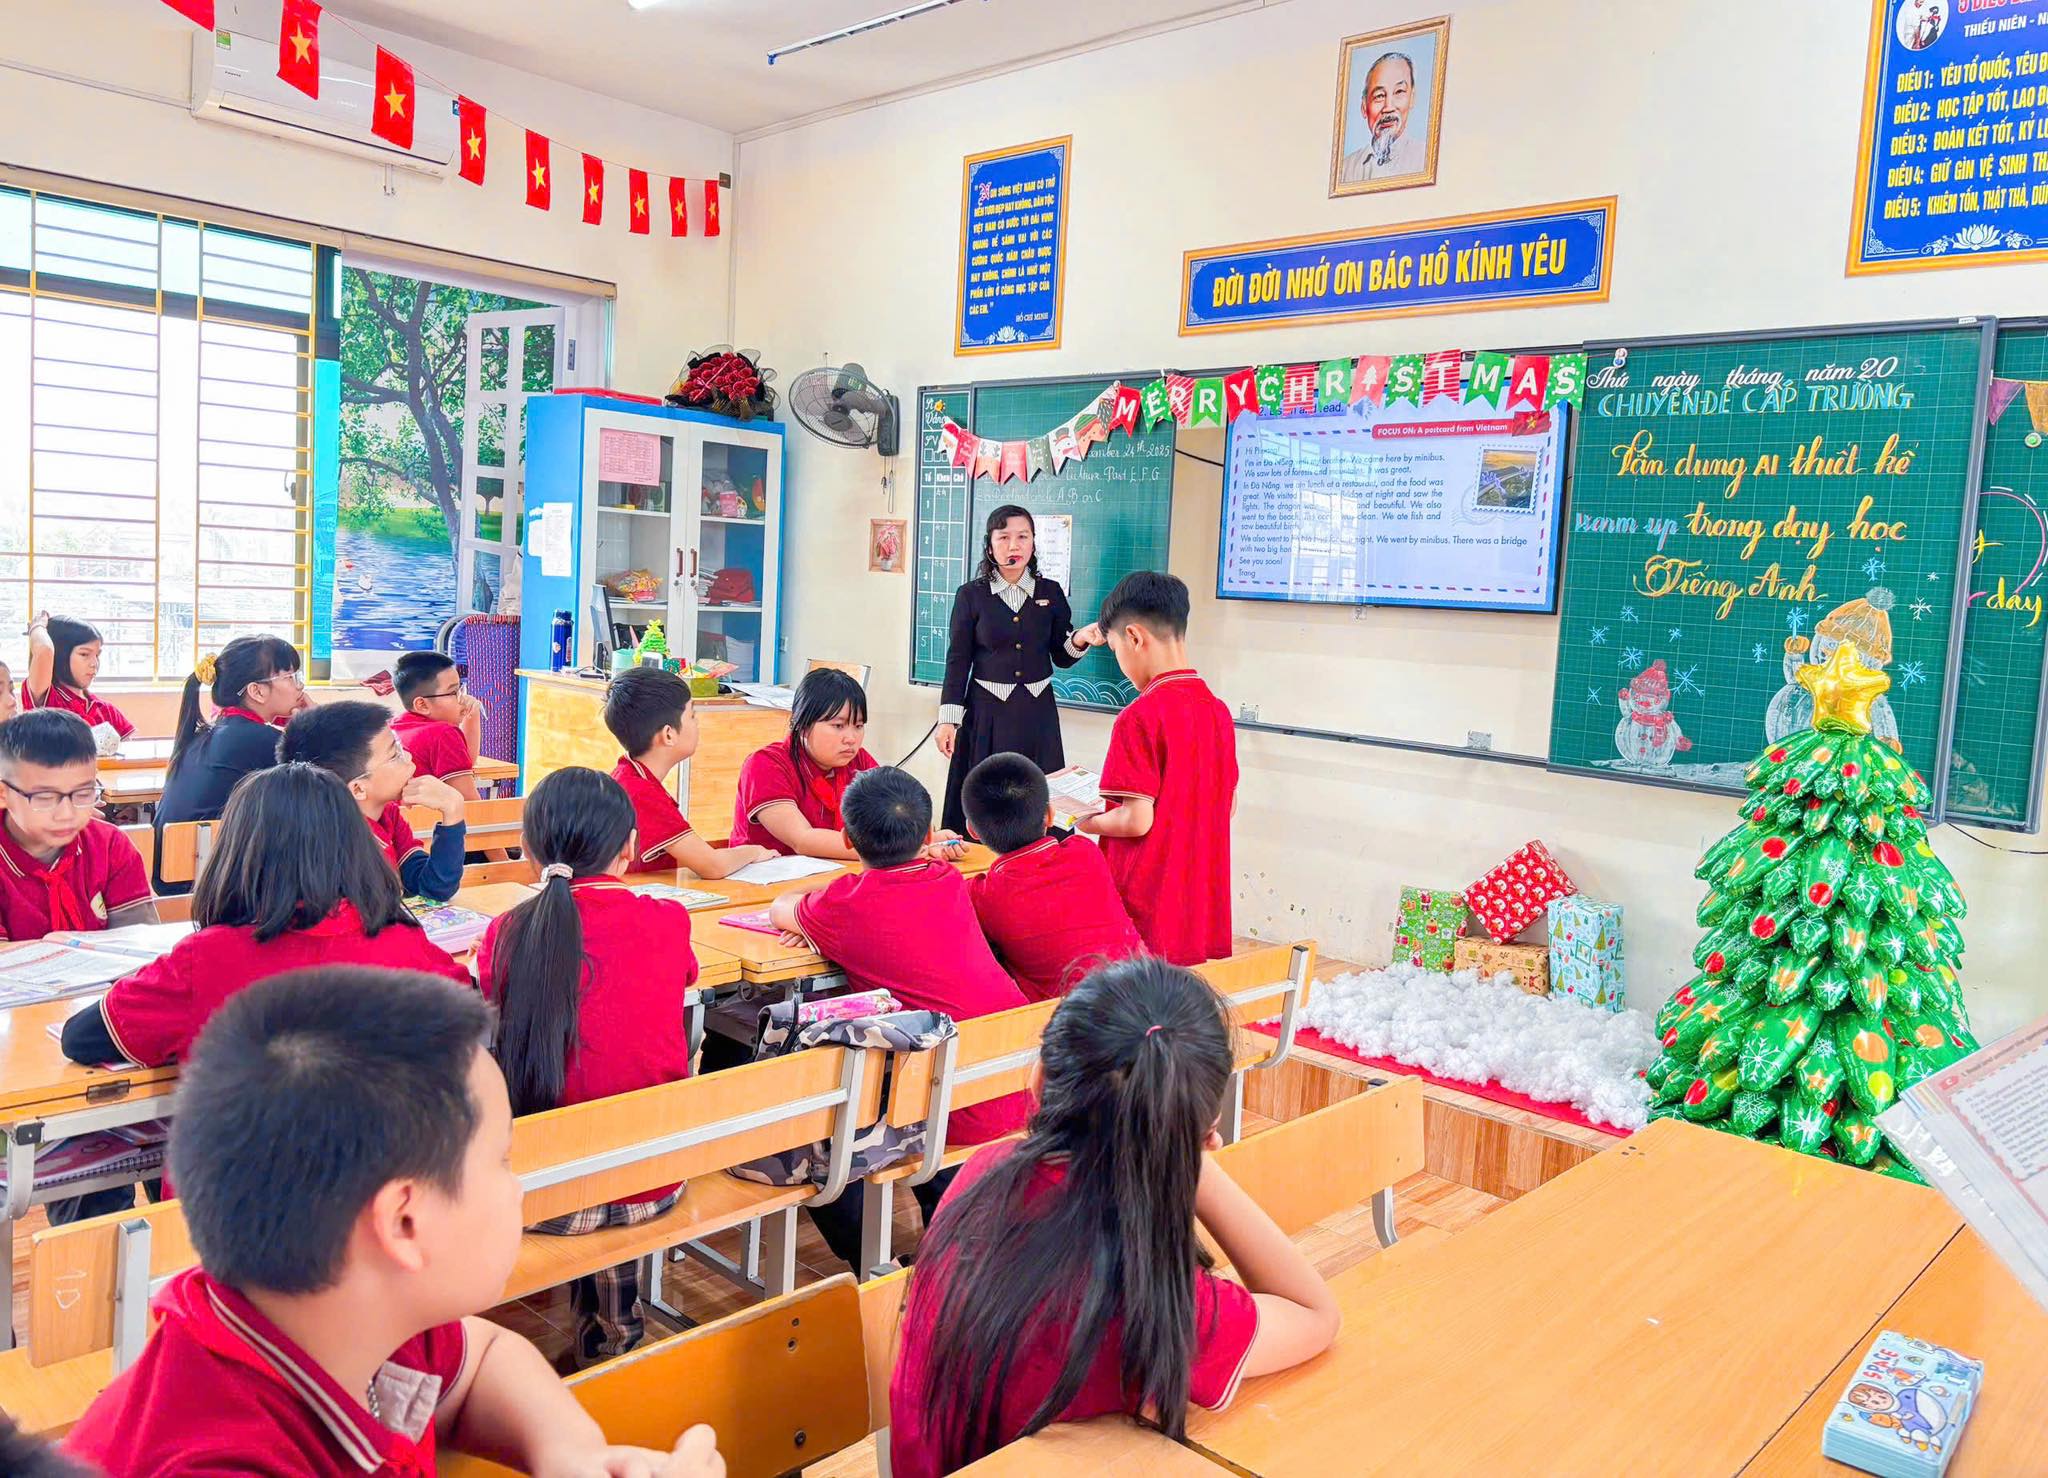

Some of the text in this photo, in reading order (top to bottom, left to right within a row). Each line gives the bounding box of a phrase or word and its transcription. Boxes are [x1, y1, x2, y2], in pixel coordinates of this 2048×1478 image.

[1964, 14, 2027, 37] THIẾU NIÊN
[1897, 51, 2037, 93] ĐIỀU 1: YÊU TỔ QUỐC, YÊU
[1894, 84, 2035, 124] ĐIỀU 2: HỌC TẬP TỐT, LAO
[1891, 111, 2035, 156] ĐIỀU 3: ĐOÀN KẾT TỐT, KỶ
[1888, 153, 2028, 188] ĐIỀU 4: GIỮ GÌN VỆ SINH
[1884, 183, 2028, 219] ĐIỀU 5: KHIÊM TỐN, THẬT THÀ,
[1212, 232, 1568, 308] ĐỜI ĐỜI NHỚ ƠN BÁC HỒ KÍNH YÊU
[1586, 356, 1898, 396] Thứ ngày tháng năm 20
[1115, 378, 1250, 423] MERRY
[1742, 379, 1798, 413] CẤP
[1377, 427, 1401, 436] FOCUS
[1416, 426, 1423, 434] A
[1424, 425, 1455, 436] postcard
[1456, 425, 1474, 434] from
[1476, 423, 1508, 432] Vietnam
[1385, 452, 1445, 464] here by minibus.
[1753, 454, 1780, 475] AI
[1284, 468, 1291, 476] of
[1390, 466, 1412, 476] great.
[1380, 478, 1394, 487] and
[1396, 478, 1408, 486] the
[1410, 477, 1426, 486] food
[1264, 492, 1275, 500] We
[1375, 489, 1394, 500] night
[1396, 489, 1411, 497] and
[1431, 489, 1443, 497] the
[1263, 502, 1275, 510] The
[1277, 502, 1301, 512] dragon
[1357, 500, 1371, 509] and
[1373, 500, 1406, 509] beautiful.
[1410, 500, 1423, 508] We
[1426, 500, 1442, 508] also
[1266, 512, 1277, 520] the
[1357, 512, 1378, 520] clean.
[1382, 511, 1394, 520] We
[1397, 512, 1408, 520] ate
[1411, 511, 1423, 520] fish
[1426, 511, 1441, 520] and
[1255, 522, 1282, 530] beautiful
[1643, 517, 1679, 551] up
[1684, 502, 1766, 560] trong
[1772, 505, 1835, 559] dạy
[1847, 495, 1907, 552] học
[1267, 544, 1278, 554] big
[1409, 535, 1418, 545] by
[1420, 536, 1450, 544] minibus.
[1453, 536, 1474, 544] There
[1501, 535, 1527, 547] bridge
[1252, 558, 1263, 566] you
[1266, 557, 1282, 565] soon!
[1633, 555, 1829, 620] Tiếng Anh
